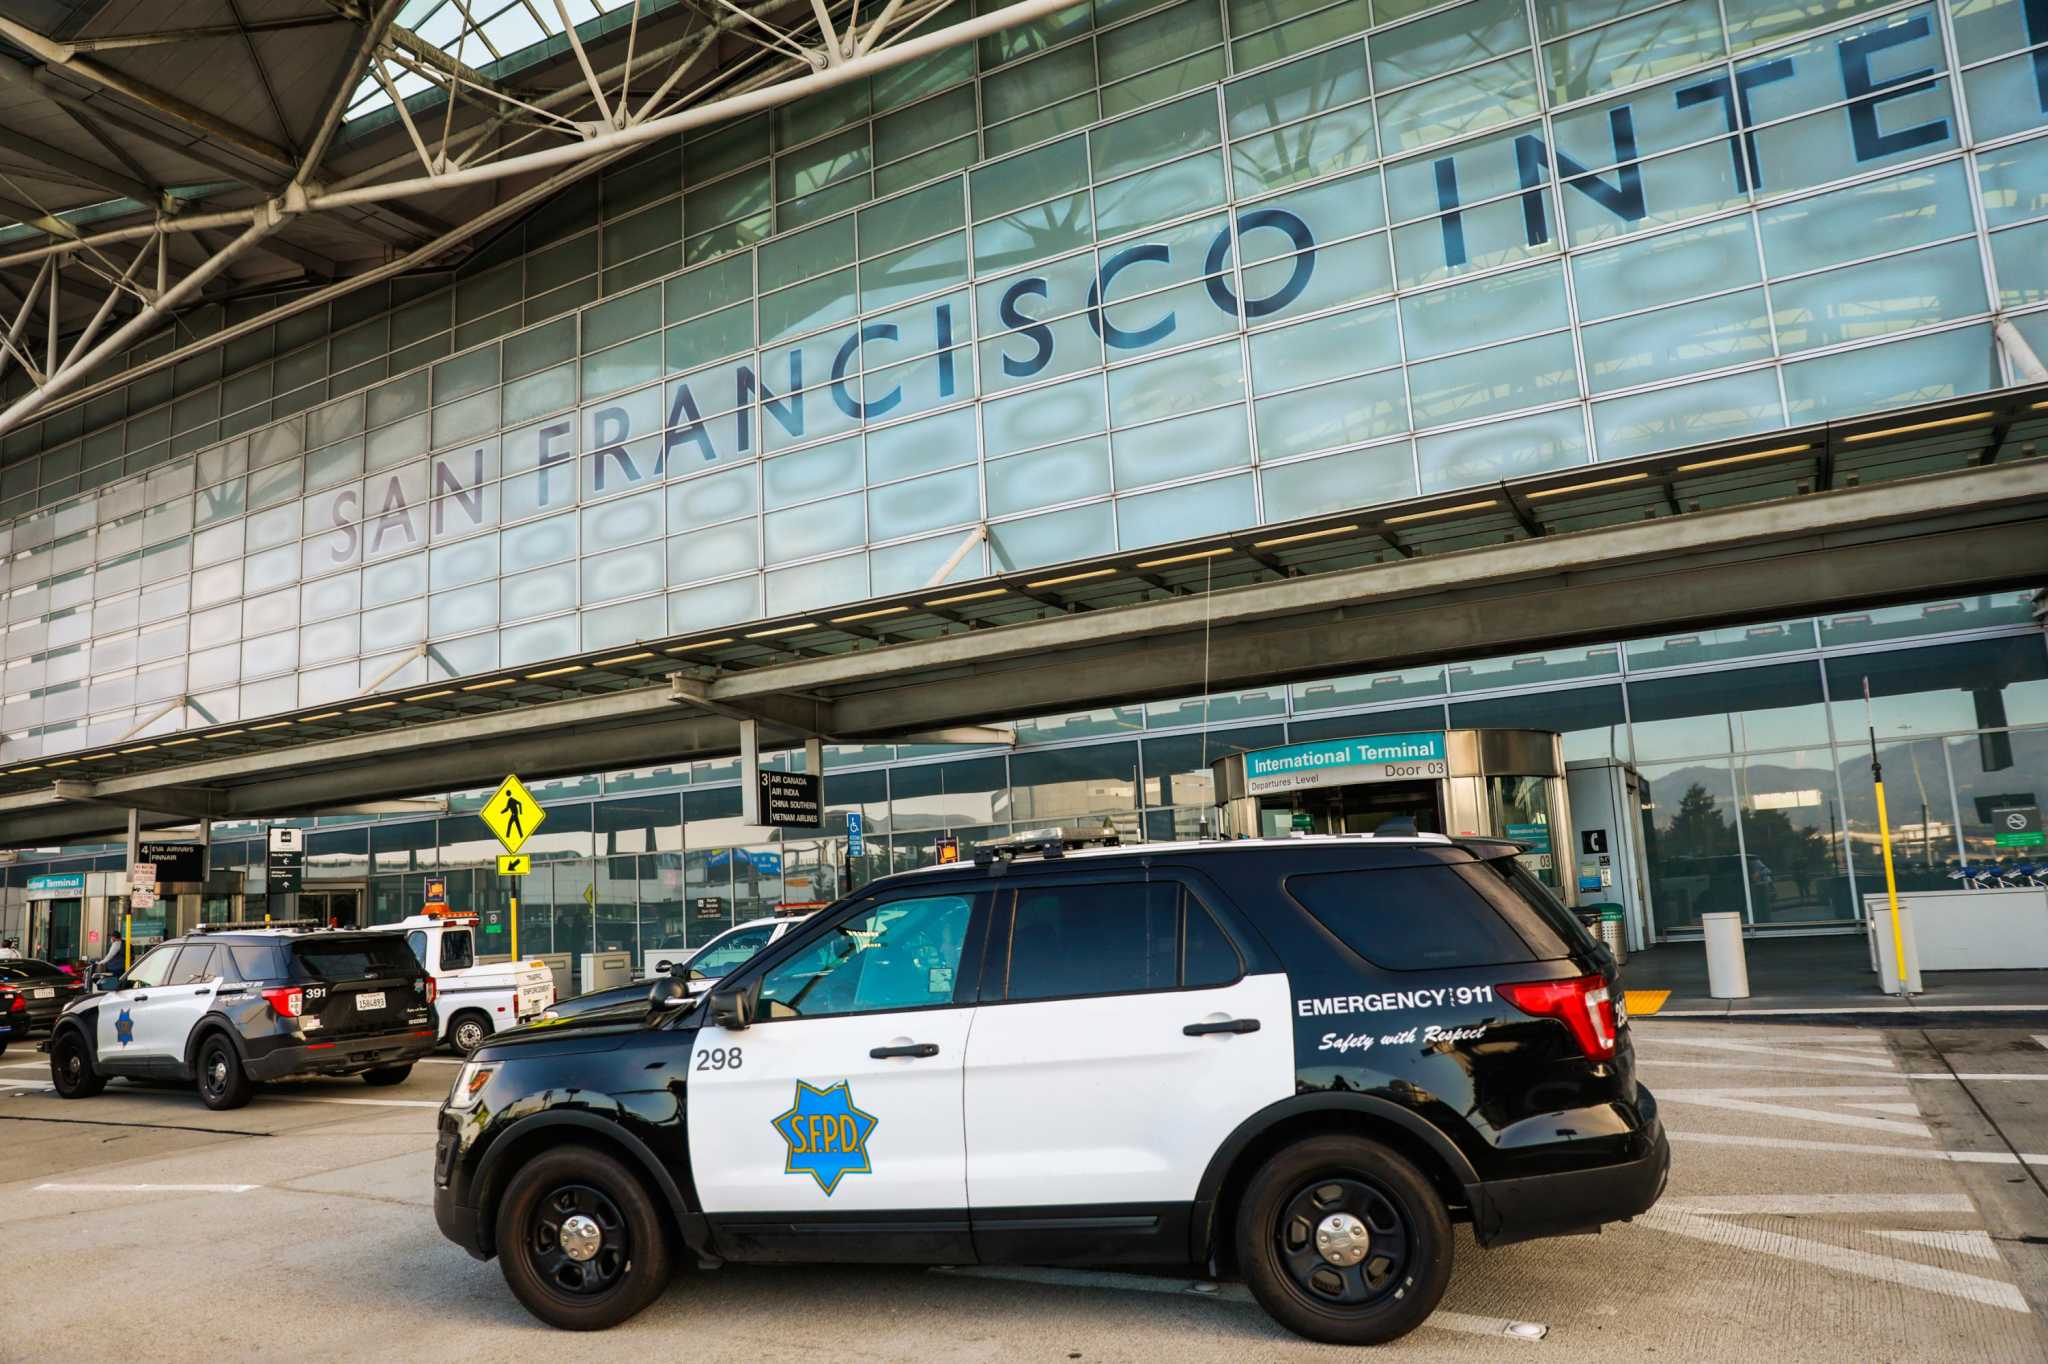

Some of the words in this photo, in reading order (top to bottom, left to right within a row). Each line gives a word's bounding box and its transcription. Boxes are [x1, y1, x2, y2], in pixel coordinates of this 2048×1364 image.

[330, 448, 484, 563] SAN
[537, 207, 1317, 508] FRANCISCO
[1254, 746, 1350, 774] International
[1356, 741, 1435, 760] Terminal
[1385, 765, 1421, 777] Door
[1427, 762, 1444, 775] 03
[761, 773, 769, 786] 3
[771, 775, 782, 783] AIR
[783, 776, 808, 785] CANADA
[1251, 779, 1292, 792] Departures
[1296, 774, 1320, 785] Level
[772, 787, 782, 796] AIR
[783, 788, 800, 797] INDIA
[771, 799, 789, 808] CHINA
[790, 801, 817, 810] SOUTHERN
[772, 812, 796, 822] VIETNAM
[797, 814, 818, 823] AIRLINES
[141, 845, 149, 855] 4
[47, 878, 79, 888] Terminal
[305, 987, 327, 999] 391
[1297, 989, 1446, 1017] EMERGENCY
[1456, 985, 1493, 1005] 911
[1318, 1032, 1375, 1054] Safety
[1380, 1027, 1418, 1045] with
[1423, 1025, 1487, 1043] Respect
[696, 1046, 743, 1071] 298
